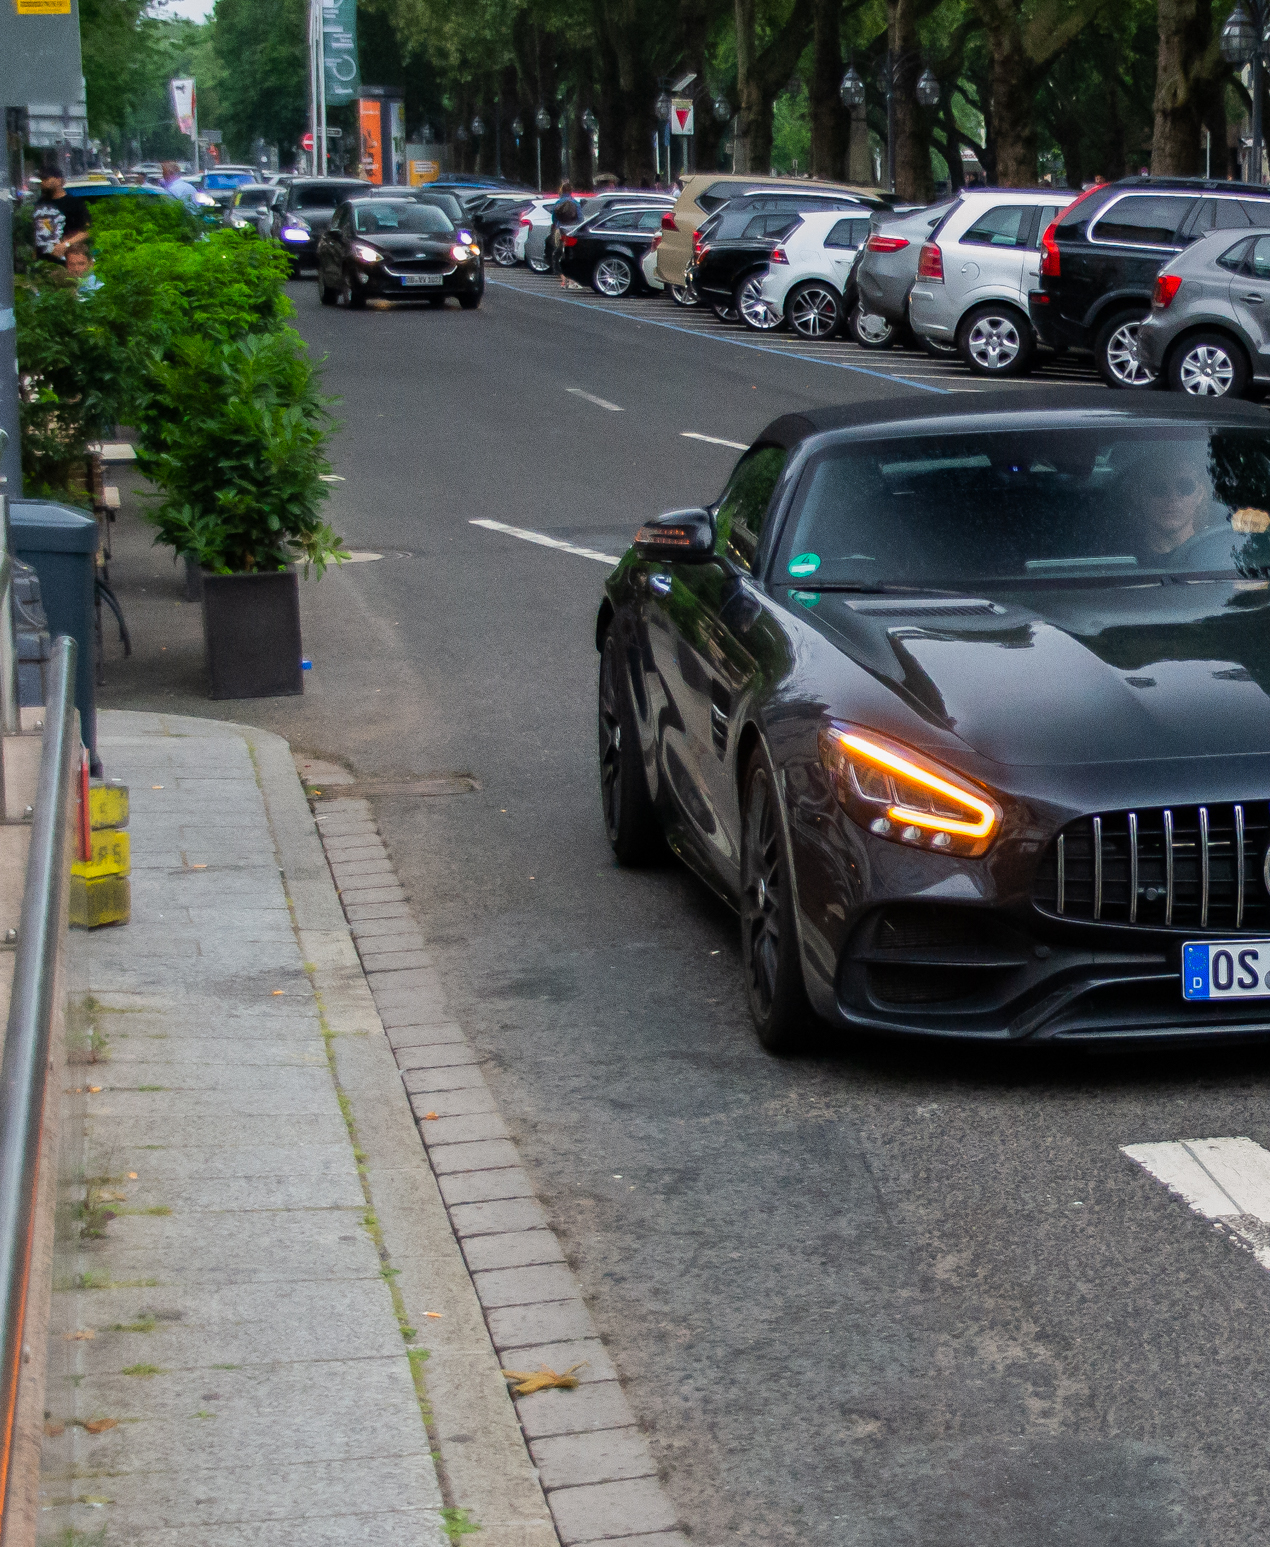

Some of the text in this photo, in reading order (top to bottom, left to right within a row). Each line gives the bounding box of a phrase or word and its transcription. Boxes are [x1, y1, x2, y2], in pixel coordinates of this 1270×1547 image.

[801, 554, 810, 564] 4
[1211, 948, 1260, 990] OS
[1192, 976, 1203, 989] D
